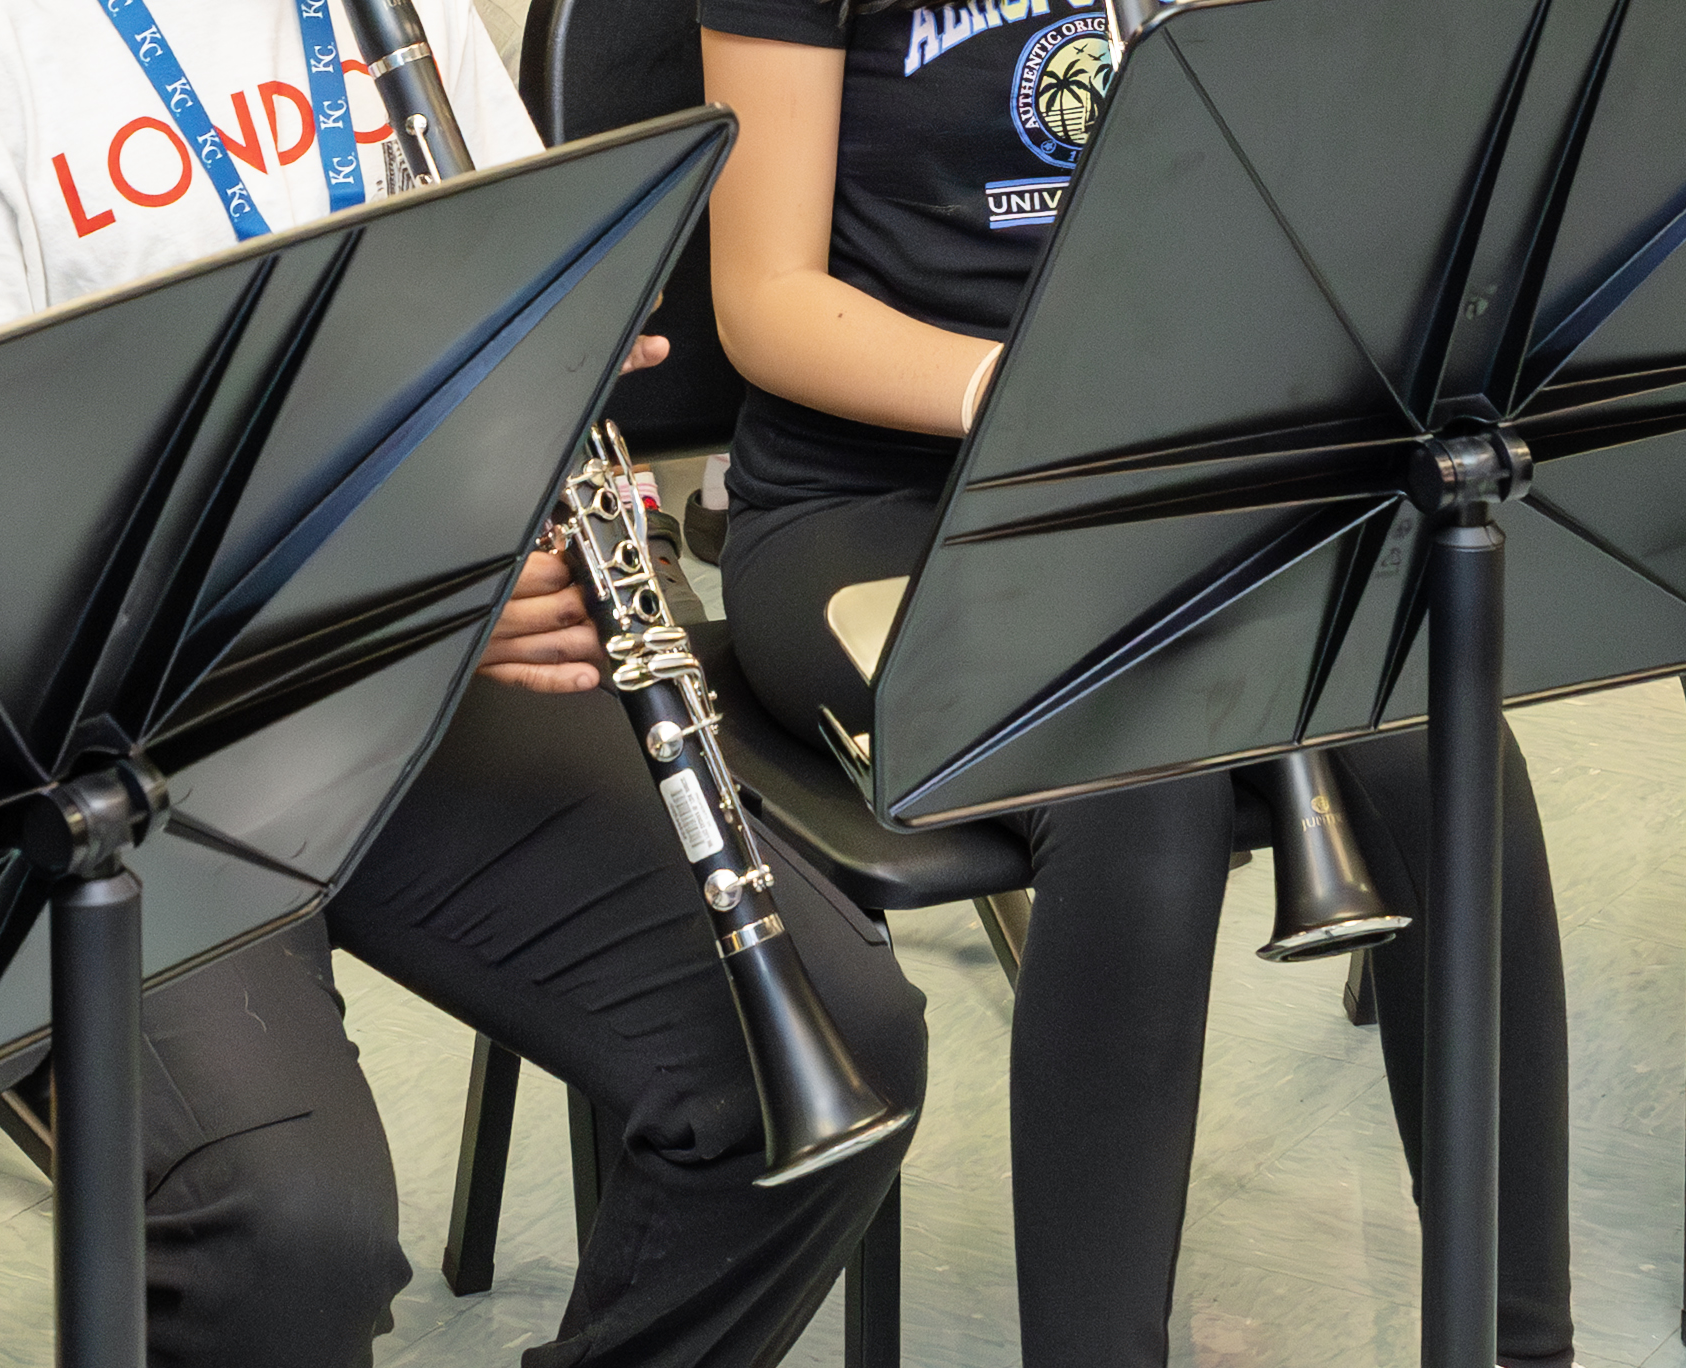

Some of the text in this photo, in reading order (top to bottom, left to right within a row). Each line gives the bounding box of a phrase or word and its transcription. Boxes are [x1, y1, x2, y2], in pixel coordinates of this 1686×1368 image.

[134, 25, 163, 63] KC
[309, 44, 336, 74] KC
[165, 76, 193, 114] KC
[1018, 30, 1062, 129] AUTHENTIC
[318, 99, 347, 131] KC
[52, 59, 442, 238] LONDO
[196, 128, 223, 165] KC
[328, 155, 357, 186] KC
[226, 182, 251, 218] KC
[988, 190, 1062, 214] UNIV
